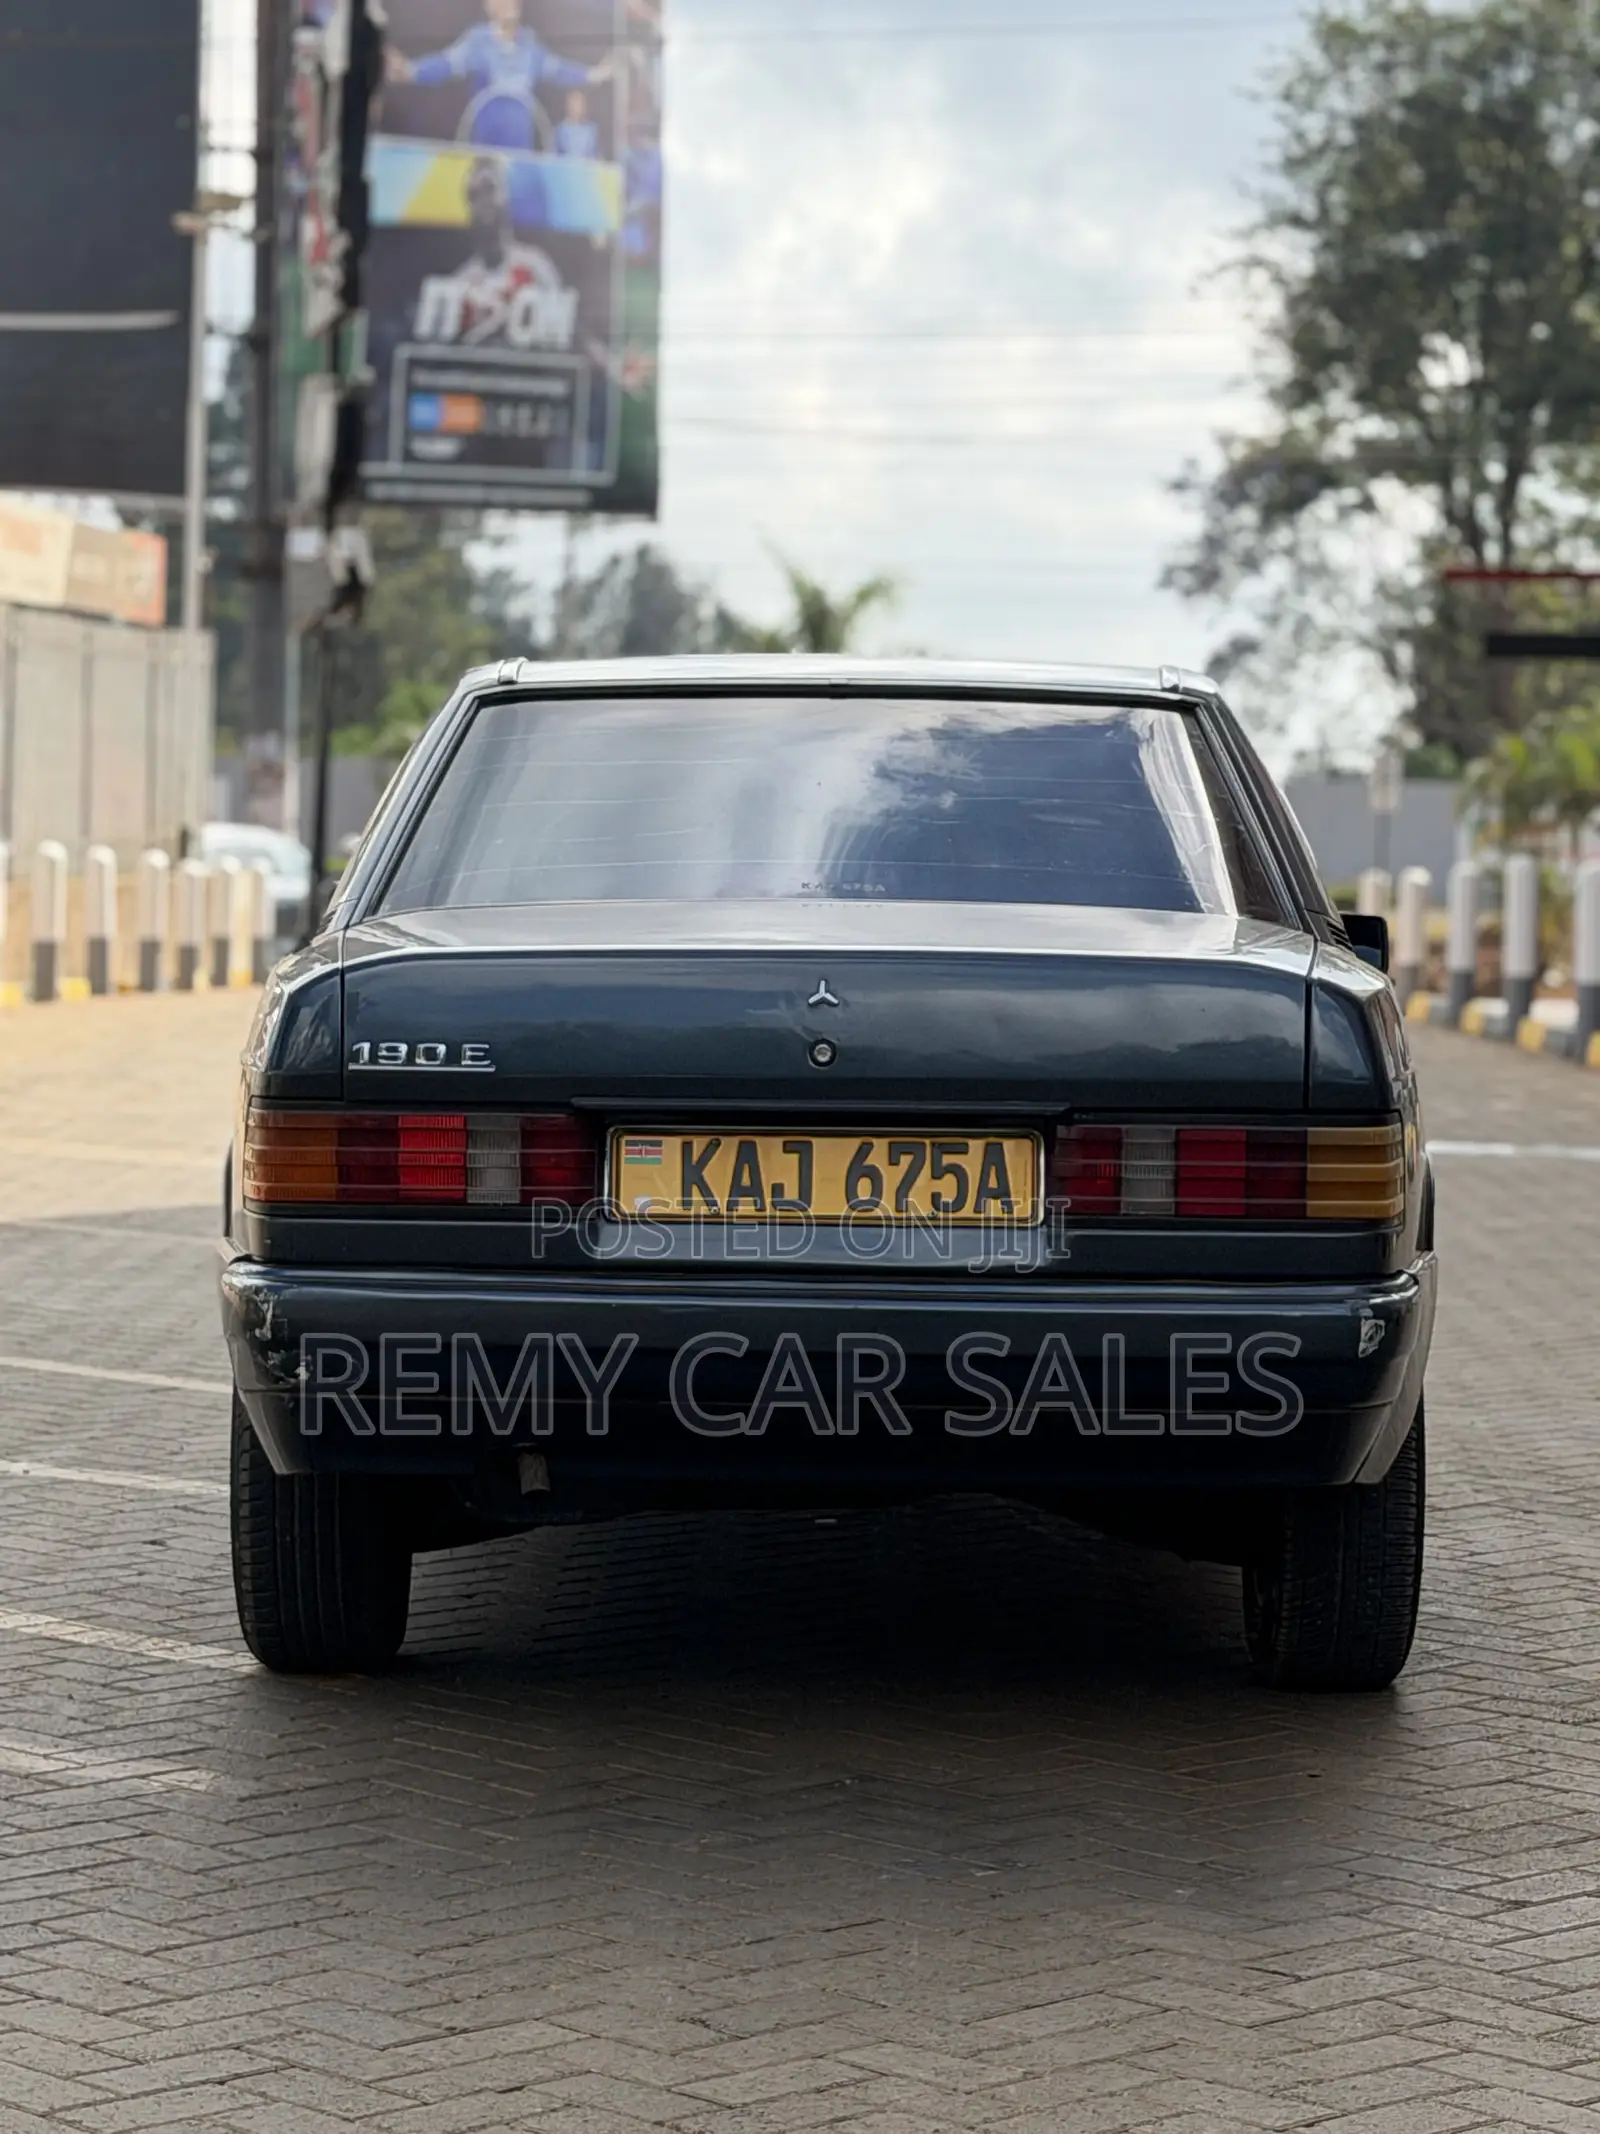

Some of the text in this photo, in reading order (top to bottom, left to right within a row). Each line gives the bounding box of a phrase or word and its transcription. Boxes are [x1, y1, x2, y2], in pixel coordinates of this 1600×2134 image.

[352, 1042, 491, 1066] 190 E
[680, 1138, 1014, 1215] KAJ 675A
